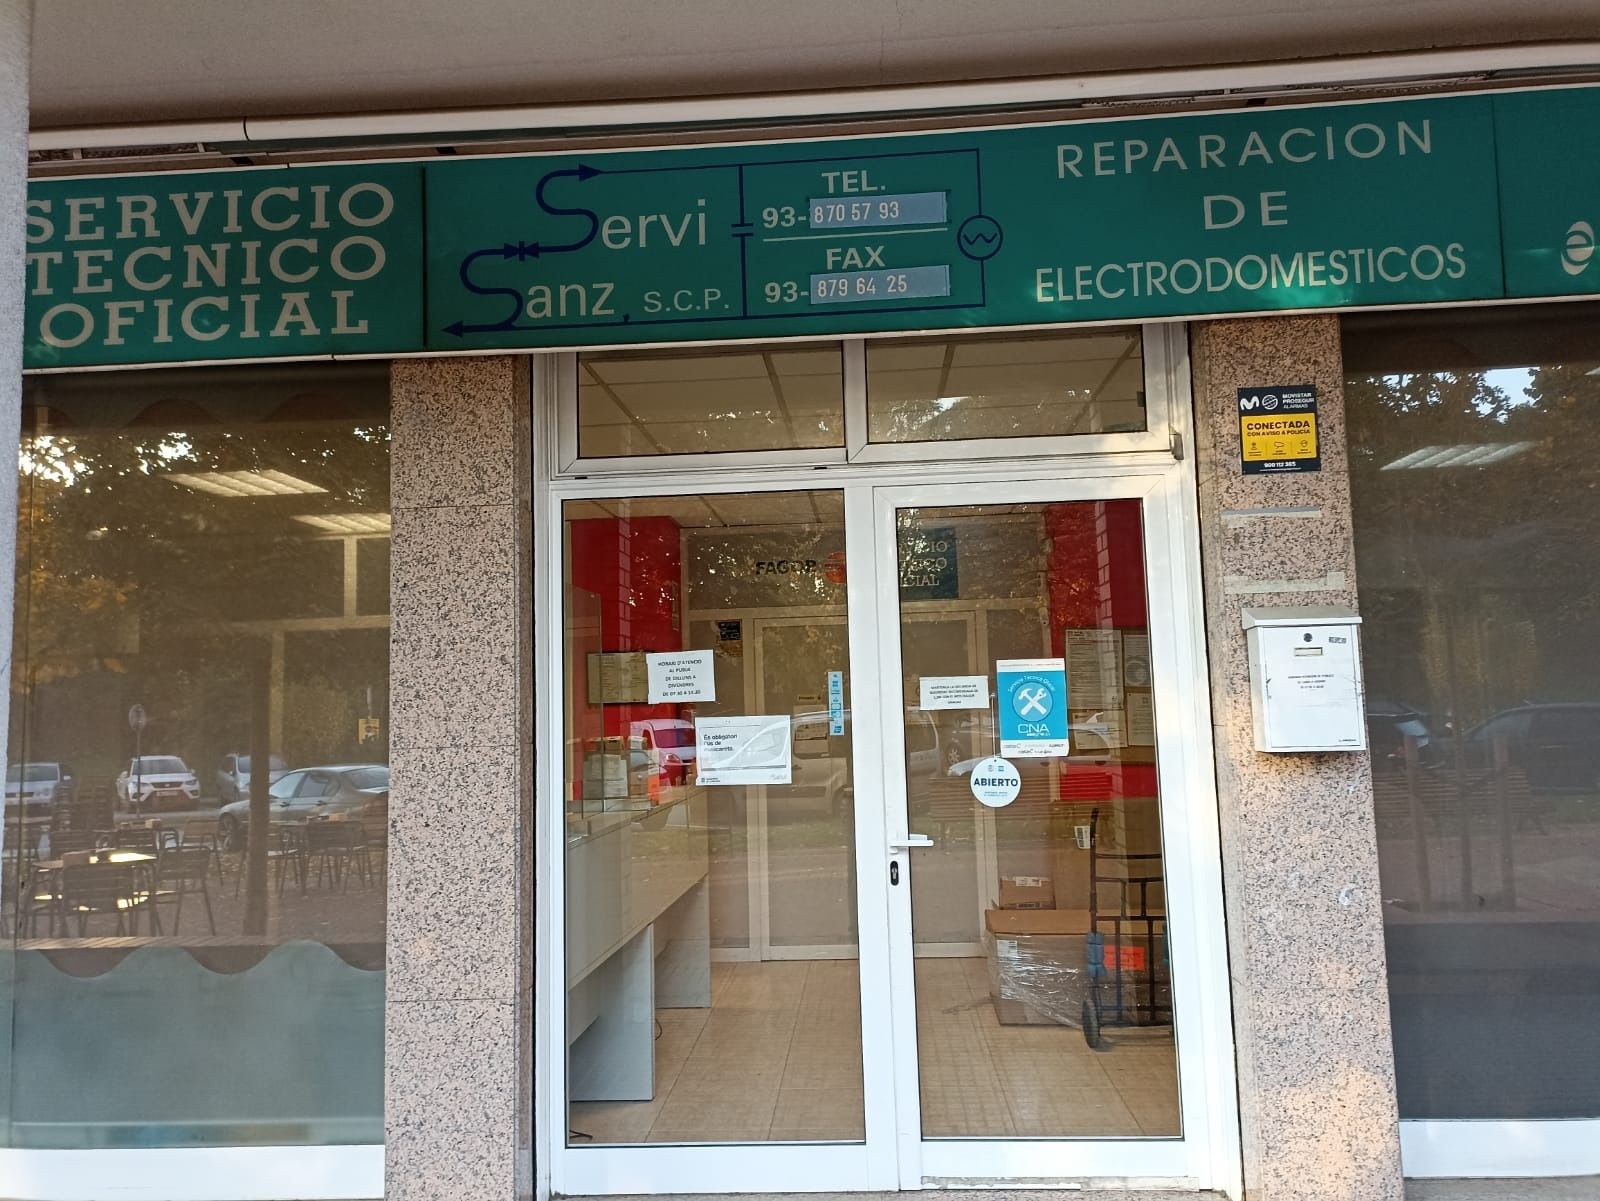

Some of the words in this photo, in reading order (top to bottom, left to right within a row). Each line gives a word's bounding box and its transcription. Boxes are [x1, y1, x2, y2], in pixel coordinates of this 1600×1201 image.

[1056, 119, 1432, 180] REPARACION
[821, 170, 886, 194] TEL.
[26, 183, 394, 244] SERVICIO
[851, 203, 871, 222] 57
[879, 201, 900, 220] 93
[1203, 190, 1289, 231] DE
[26, 236, 387, 296] TECNICO
[826, 245, 886, 271] FAX
[856, 277, 876, 296] 64
[886, 274, 908, 293] 25
[1036, 242, 1467, 303] ELECTRODOMESTICOS
[643, 287, 730, 314] S.C.P.
[39, 290, 369, 348] OFICIAL
[1246, 420, 1311, 431] CONECTADA
[1017, 723, 1050, 734] CNA
[973, 777, 1019, 787] ABIERTO
